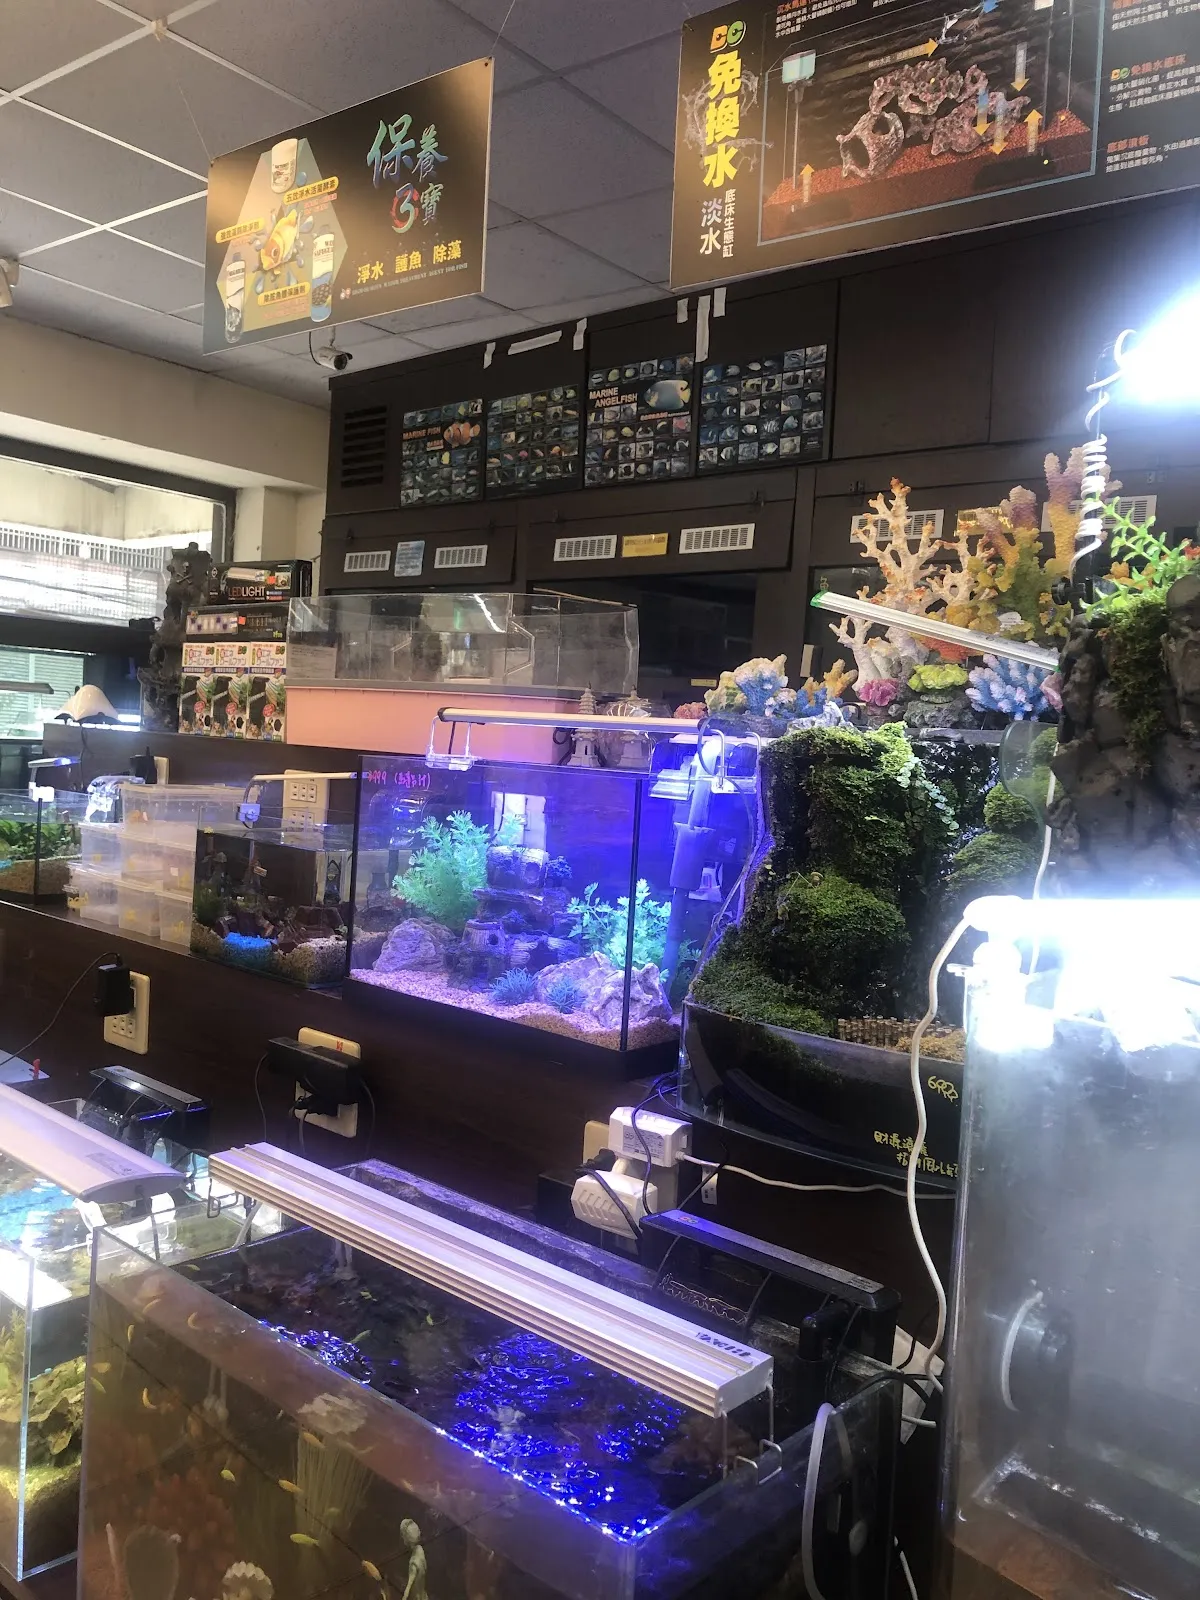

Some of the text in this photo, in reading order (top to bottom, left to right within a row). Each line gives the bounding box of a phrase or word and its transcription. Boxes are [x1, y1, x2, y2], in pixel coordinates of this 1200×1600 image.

[703, 50, 742, 188] 免換水
[367, 114, 448, 188] 保養
[699, 198, 723, 254] 淡水
[723, 189, 736, 257] 底床生態缸
[357, 240, 461, 284] 淨水 護魚 除藻
[589, 387, 618, 399] MARINE
[595, 393, 637, 408] ANGELFISH
[403, 427, 441, 440] MARINE FISH
